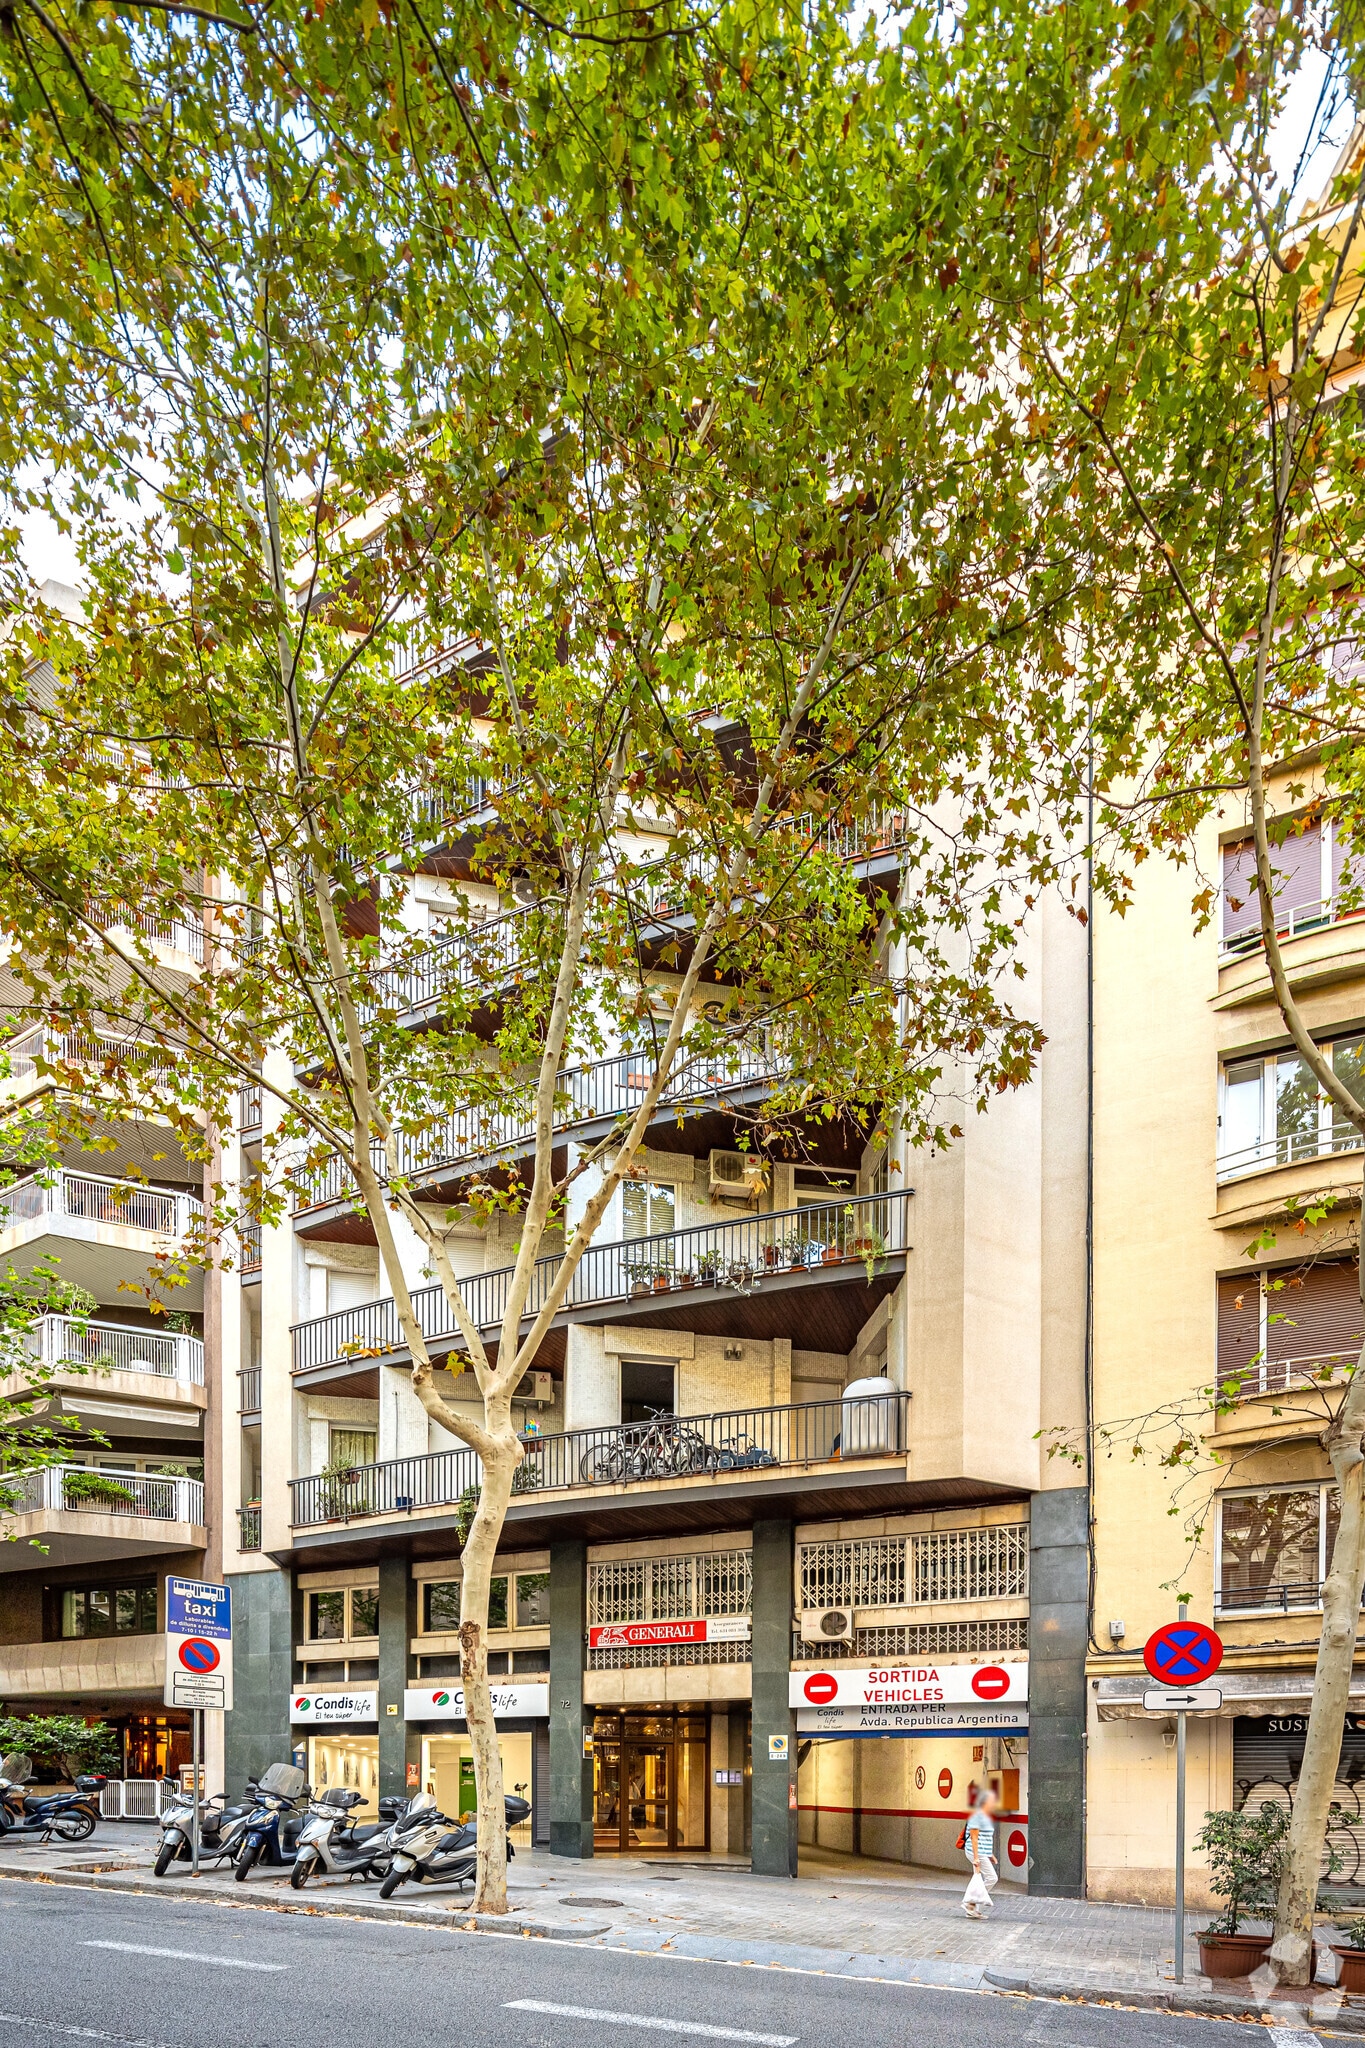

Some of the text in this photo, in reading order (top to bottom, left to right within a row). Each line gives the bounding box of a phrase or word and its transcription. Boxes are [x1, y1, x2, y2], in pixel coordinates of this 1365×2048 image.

[184, 1600, 216, 1617] taxi
[184, 1616, 215, 1625] Laborables
[203, 1624, 229, 1632] divendres
[629, 1624, 695, 1641] GENERALI
[868, 1669, 940, 1684] SORTIDA
[498, 1694, 518, 1710] life
[863, 1688, 944, 1703] VEHICLES
[314, 1696, 371, 1715] Condis life
[455, 1707, 462, 1715] El
[561, 1700, 571, 1709] 72
[860, 1703, 946, 1715] ENTRADA PER
[817, 1709, 844, 1717] Condis
[860, 1713, 1019, 1728] Avda. Republica Argentina
